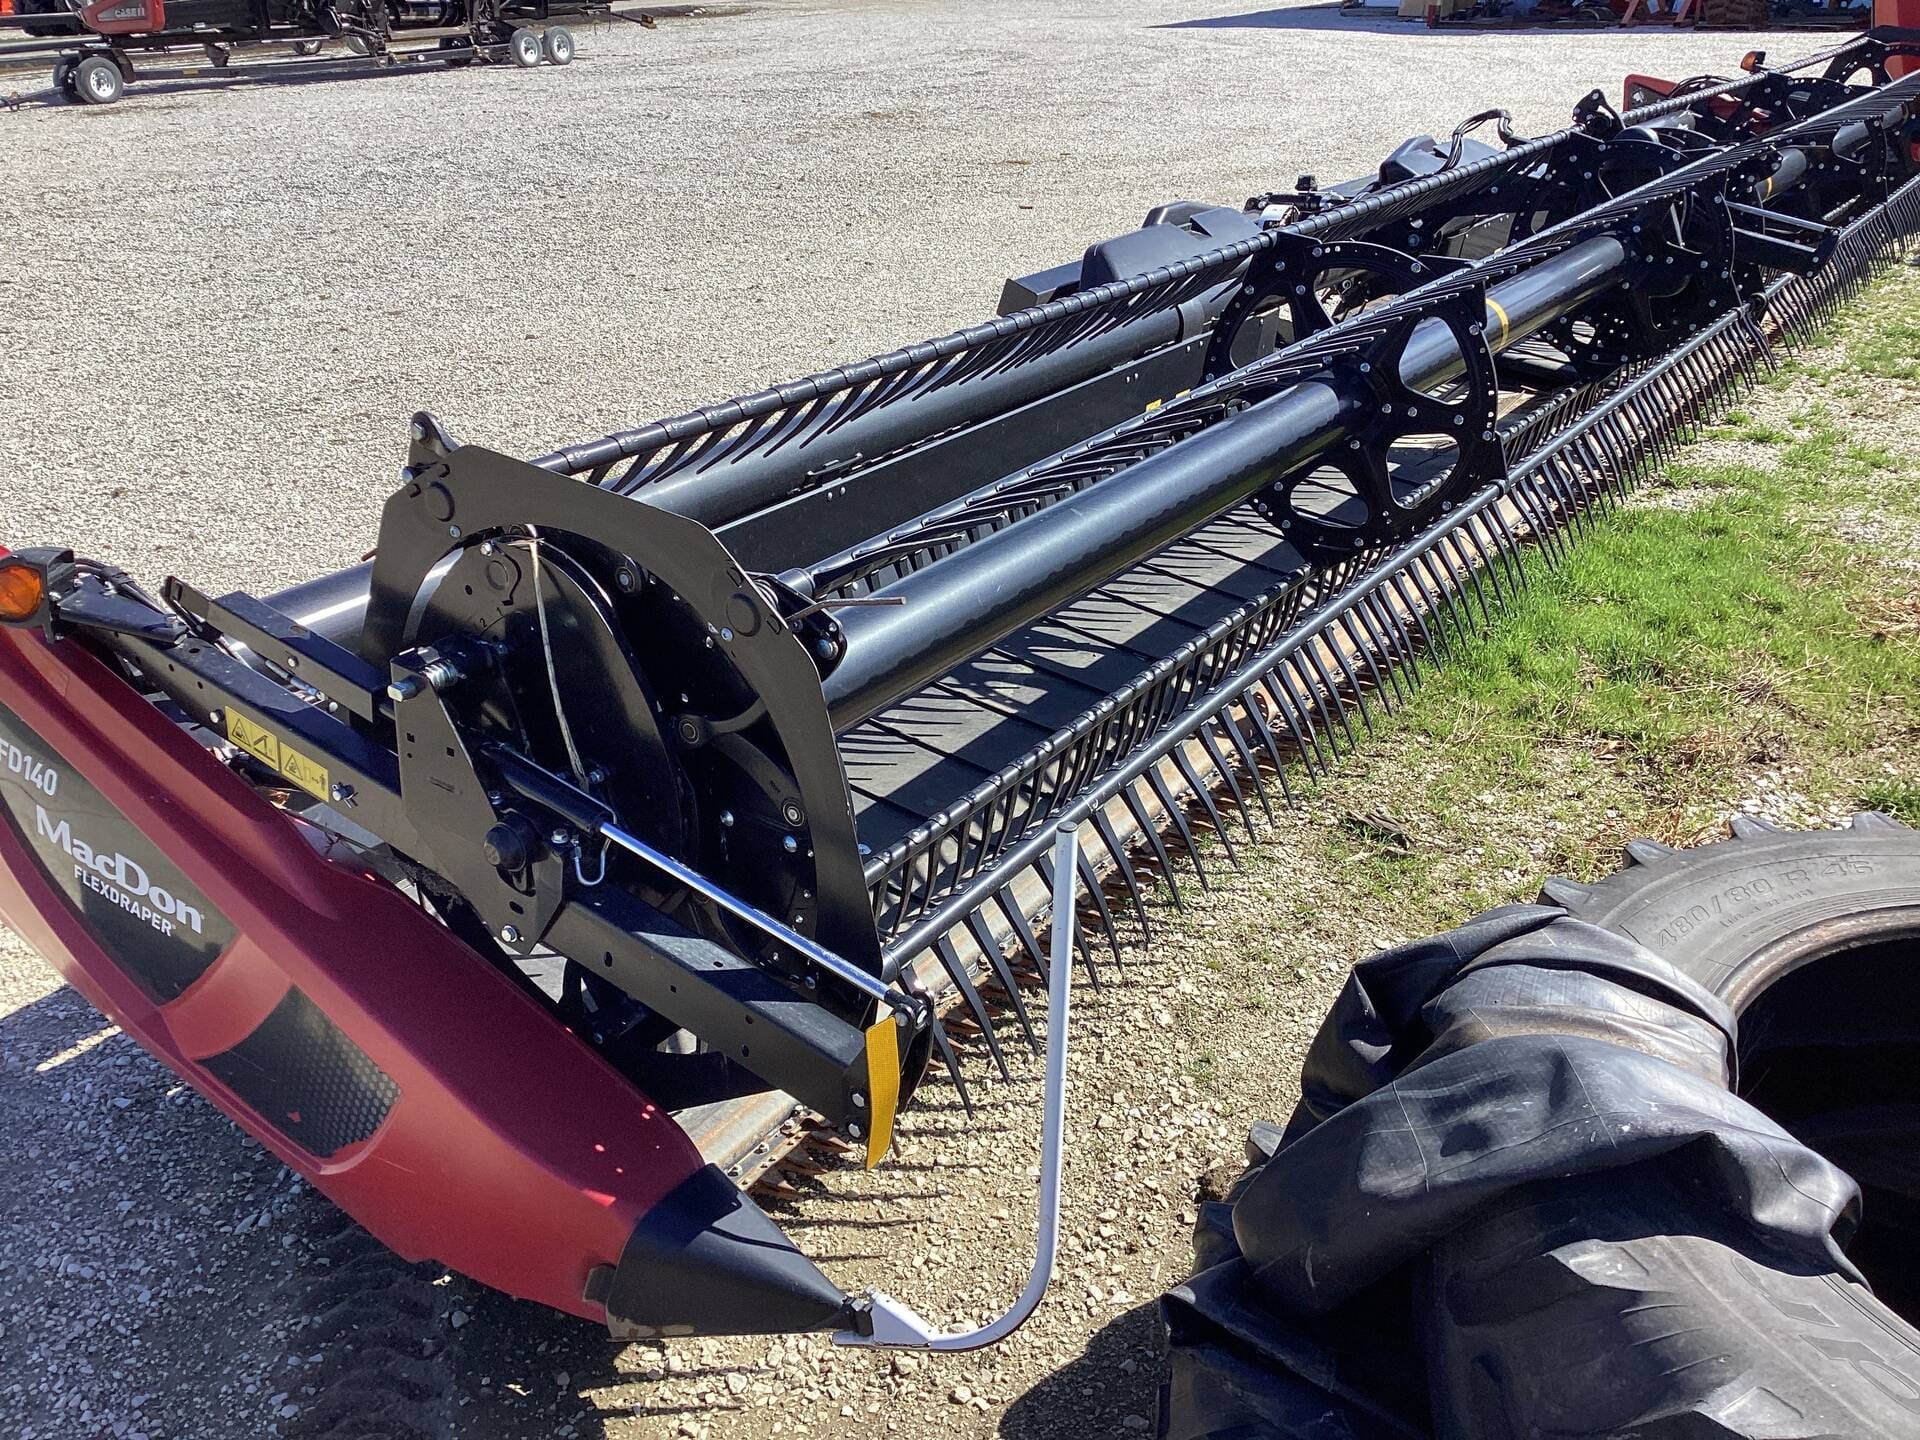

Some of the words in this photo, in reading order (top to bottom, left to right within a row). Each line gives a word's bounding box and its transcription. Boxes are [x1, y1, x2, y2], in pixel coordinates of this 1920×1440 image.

[115, 7, 137, 17] CASE
[0, 738, 57, 796] FD140
[36, 805, 202, 934] MacDon
[74, 864, 173, 937] FLEXDRAPER
[1658, 878, 1775, 949] 480/80
